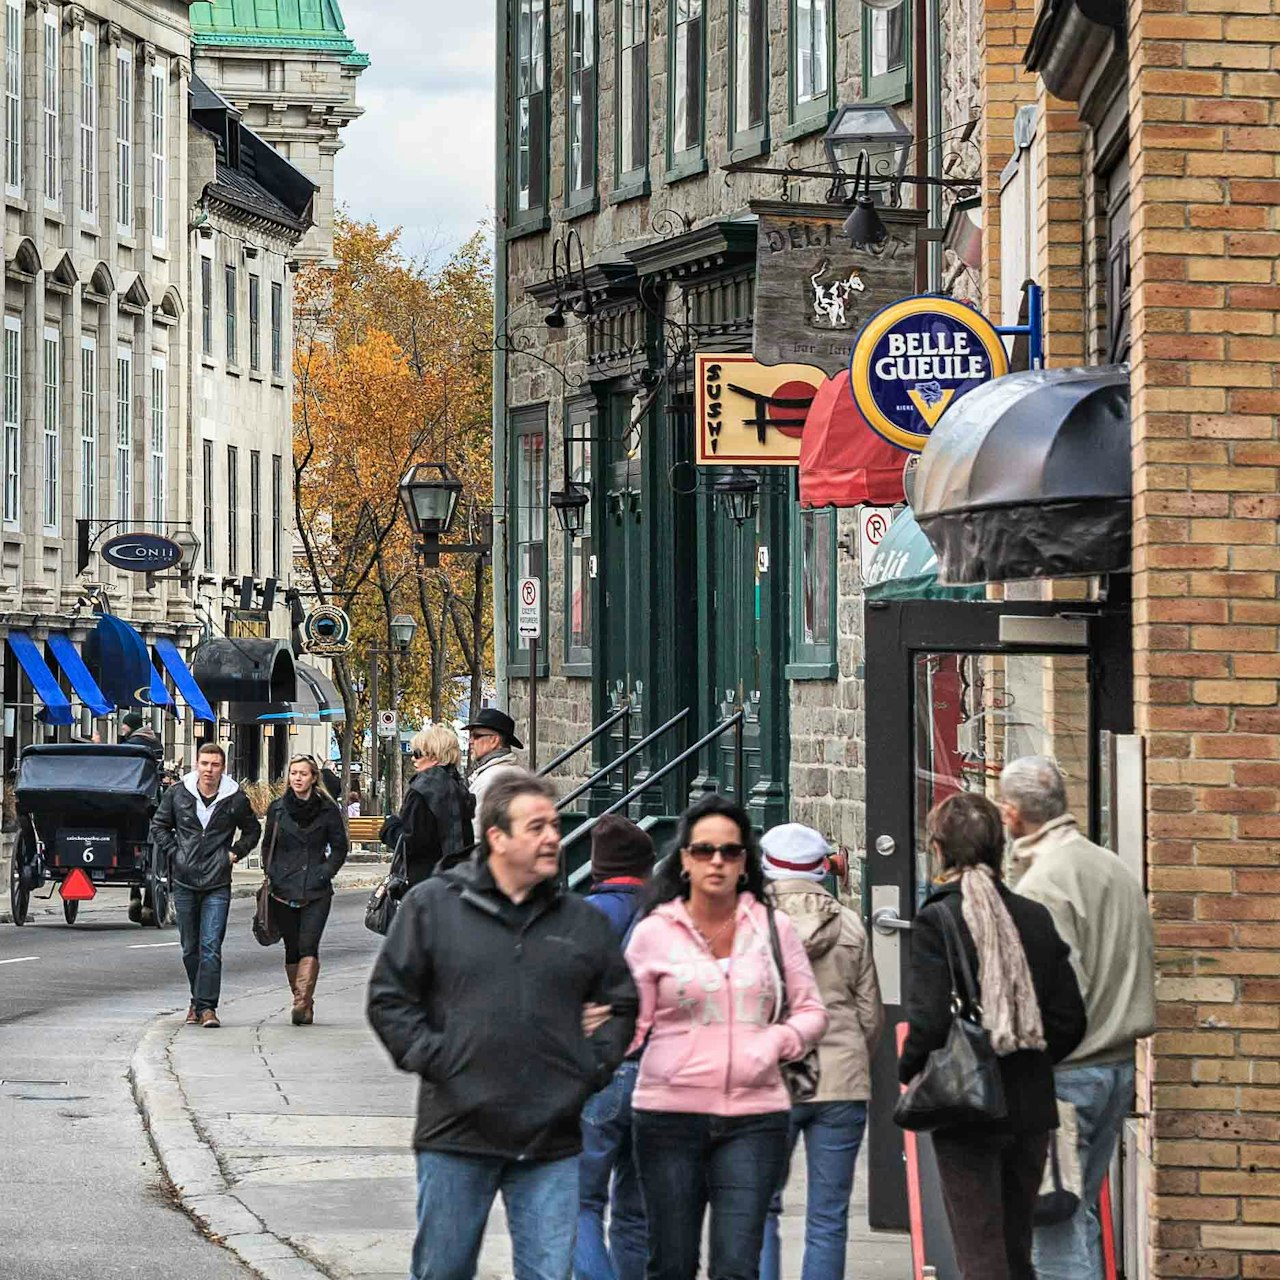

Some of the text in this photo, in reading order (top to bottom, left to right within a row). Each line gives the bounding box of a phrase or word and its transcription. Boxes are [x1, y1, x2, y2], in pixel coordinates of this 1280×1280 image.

[888, 331, 970, 357] BELLE
[874, 355, 986, 381] GUEULE
[706, 364, 723, 455] SUSHI
[82, 847, 95, 863] 6
